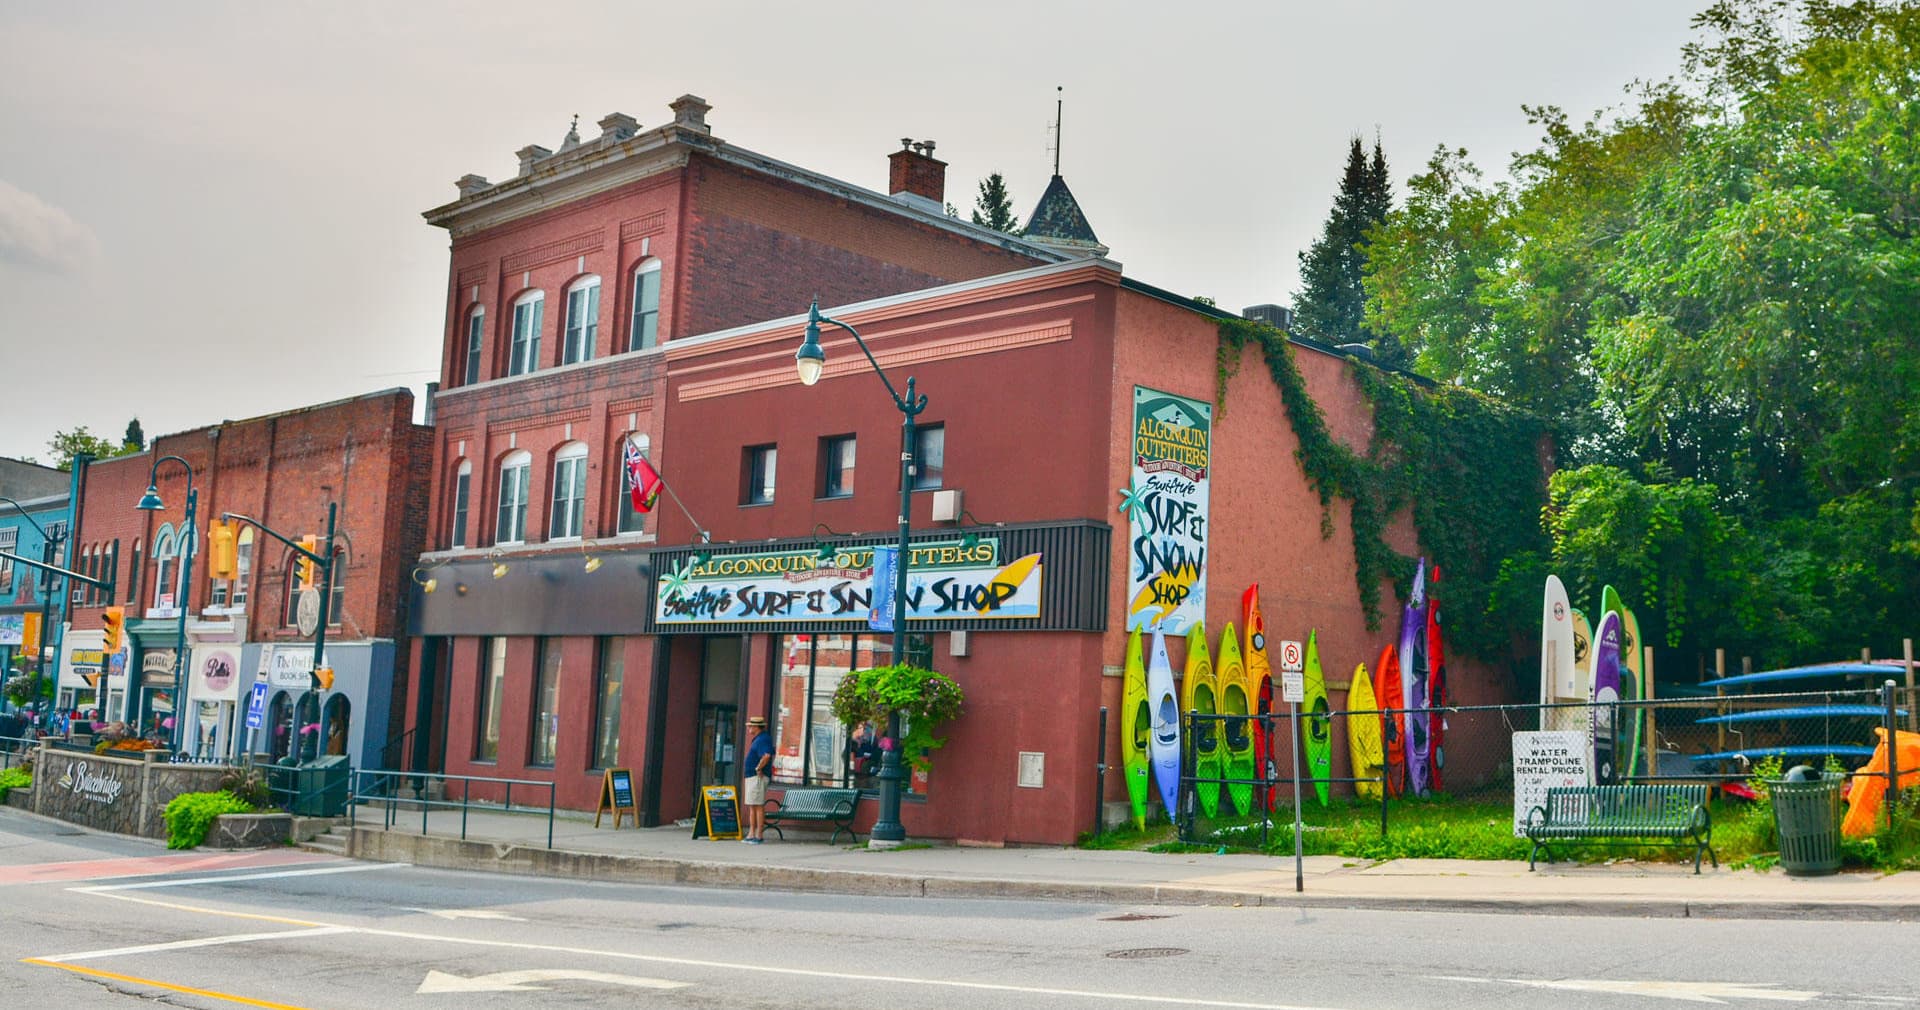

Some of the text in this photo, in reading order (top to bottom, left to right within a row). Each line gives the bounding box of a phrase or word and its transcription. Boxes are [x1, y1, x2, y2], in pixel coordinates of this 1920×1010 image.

[1138, 417, 1207, 448] ALGONQUIN
[1136, 437, 1208, 467] OUTFITTERS
[1144, 491, 1197, 536] SURF
[692, 554, 817, 577] ALGONQUIN
[1133, 535, 1204, 582] SNOW
[737, 585, 806, 616] SURF
[932, 577, 1018, 613] SHOP
[1149, 576, 1190, 605] SHOP
[1519, 757, 1581, 766] TRAMPOLINE
[1531, 748, 1568, 756] WATER
[1516, 766, 1585, 775] RENTAL PRICES
